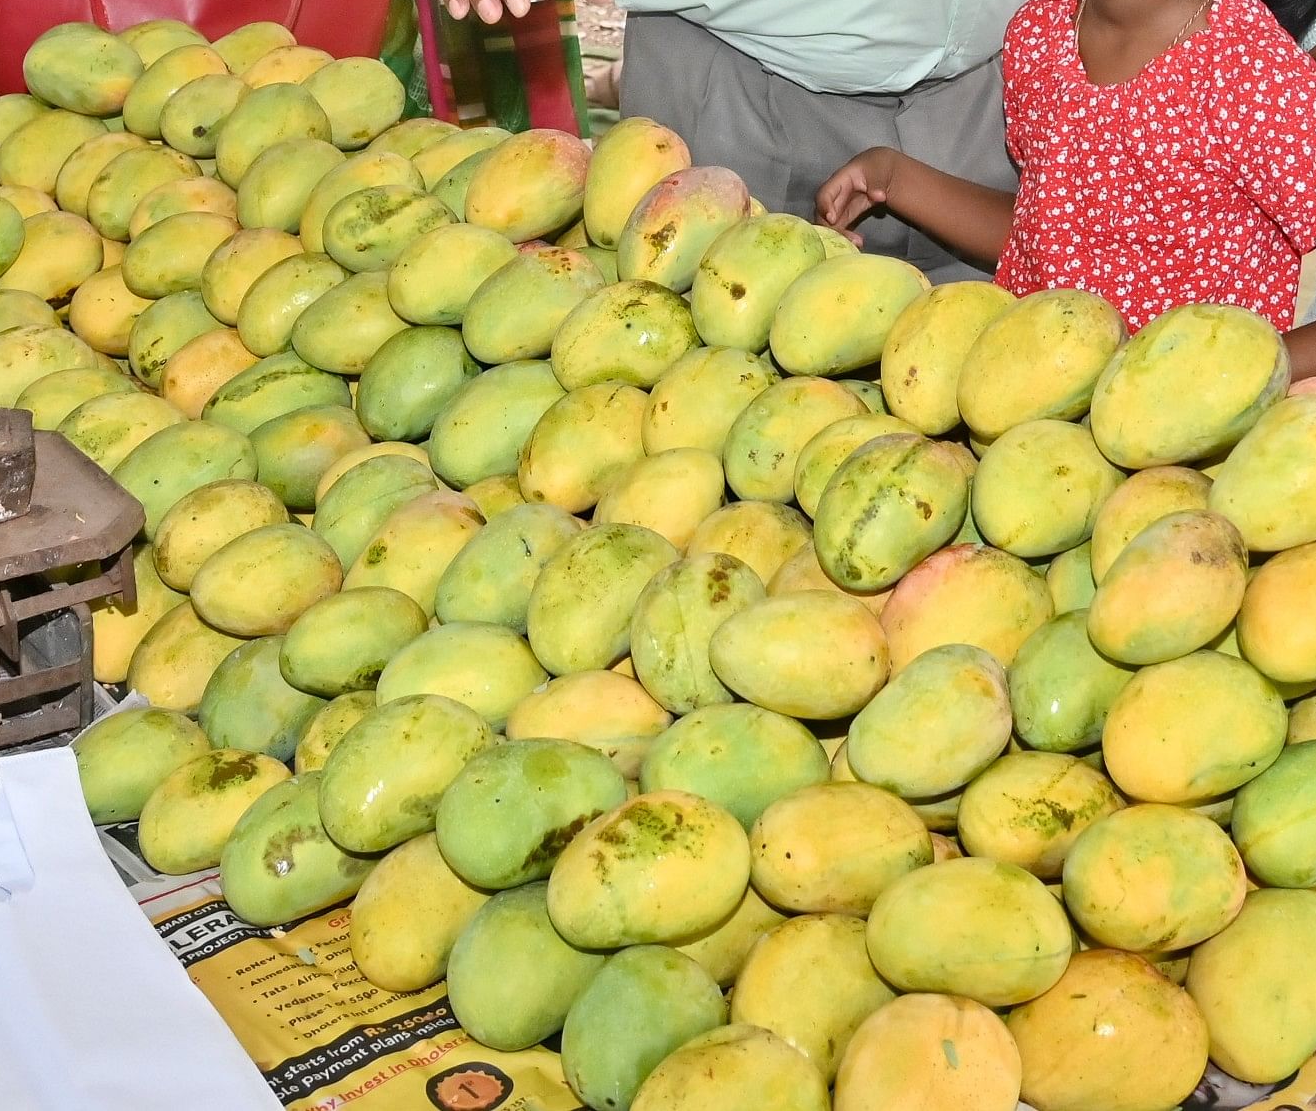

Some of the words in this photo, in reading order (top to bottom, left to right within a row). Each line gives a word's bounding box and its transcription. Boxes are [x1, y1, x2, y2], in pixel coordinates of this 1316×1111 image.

[192, 902, 218, 917] CITY
[168, 912, 238, 955] LERA
[188, 929, 244, 960] PROJECT
[235, 953, 275, 976] ReNew
[260, 983, 287, 999] Tata
[274, 991, 324, 1011] Vedanta
[283, 1052, 326, 1081] starts
[326, 1032, 365, 1059] from
[301, 1047, 368, 1089] payment
[369, 1028, 412, 1053] plans
[339, 1070, 387, 1101] Invest
[389, 1061, 405, 1075] in
